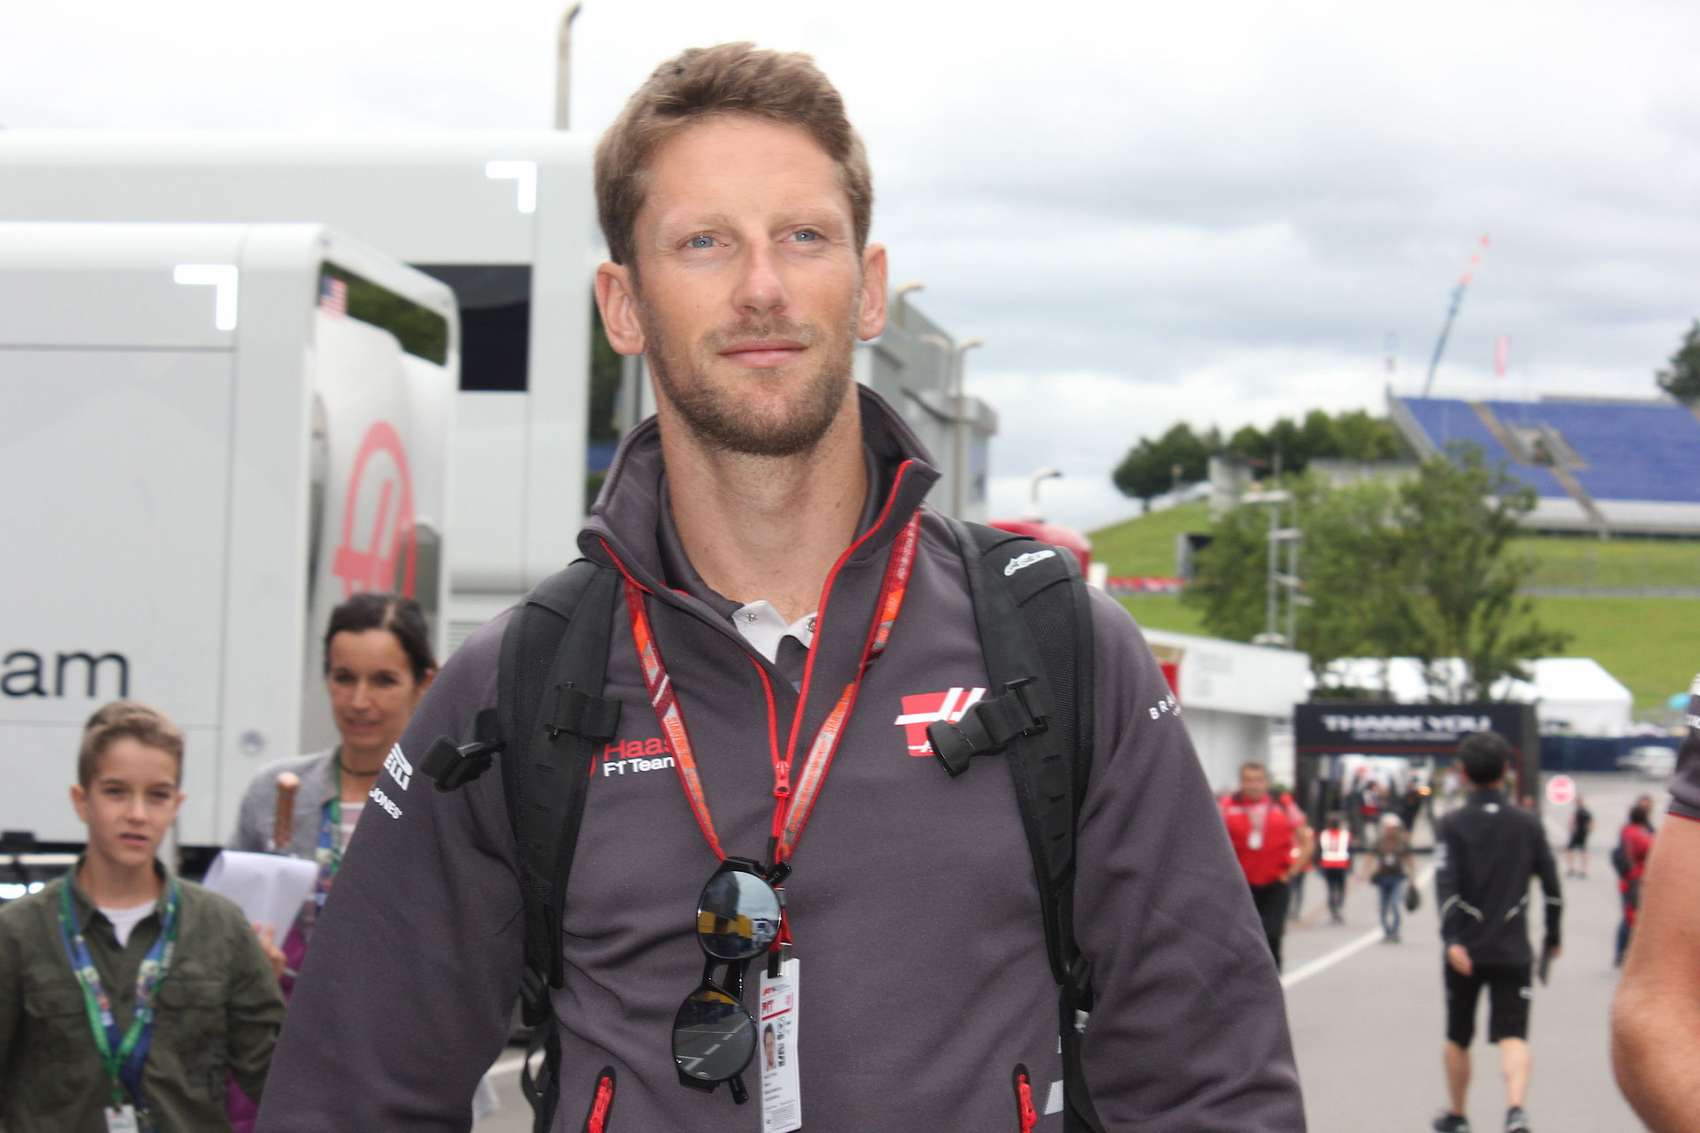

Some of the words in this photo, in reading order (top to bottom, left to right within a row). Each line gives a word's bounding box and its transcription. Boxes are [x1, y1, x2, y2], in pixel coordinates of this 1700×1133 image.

[1, 650, 129, 698] am
[1322, 714, 1423, 732] THANK
[1425, 714, 1491, 732] YOU
